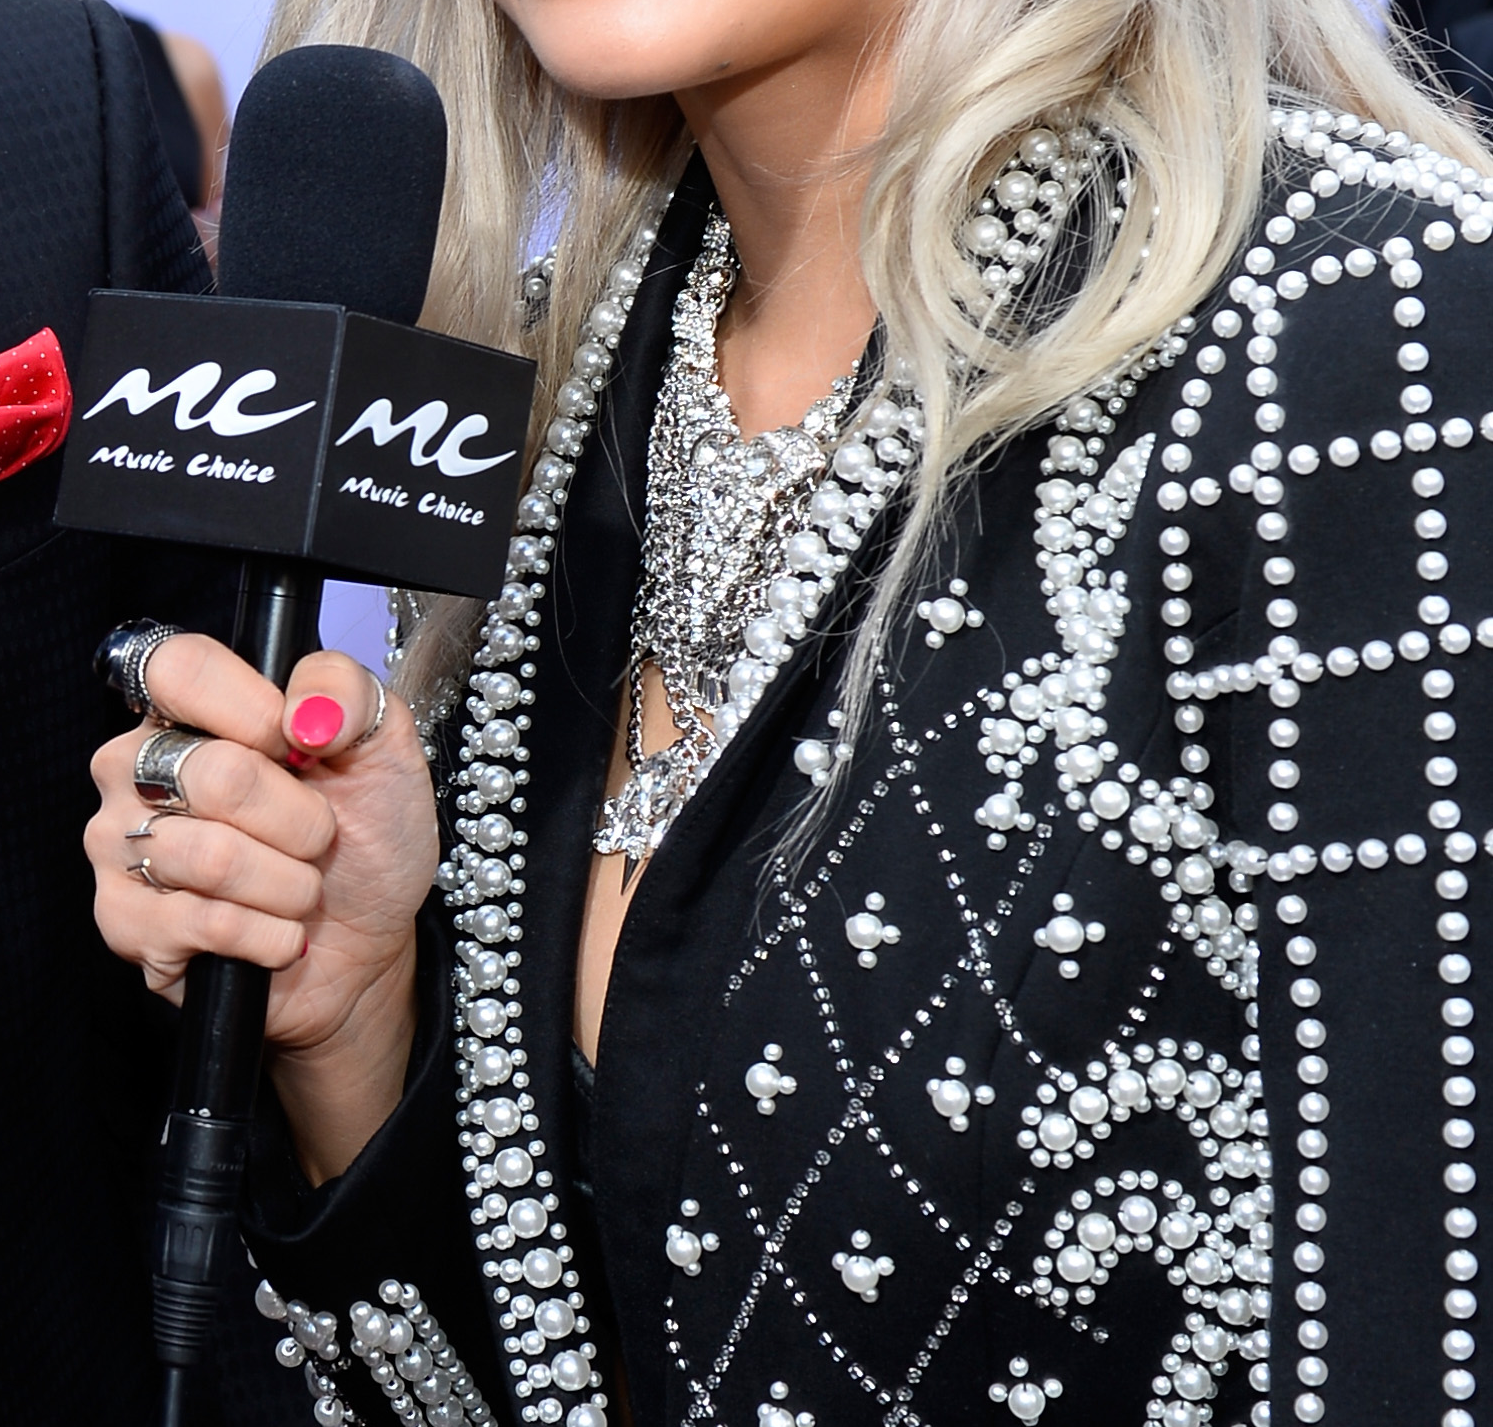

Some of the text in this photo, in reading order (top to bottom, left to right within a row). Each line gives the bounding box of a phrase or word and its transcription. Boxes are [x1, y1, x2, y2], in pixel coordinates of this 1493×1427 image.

[82, 361, 317, 437] MC
[88, 445, 277, 484] Music Choice
[335, 398, 518, 477] MC
[339, 476, 485, 526] Music Choice
